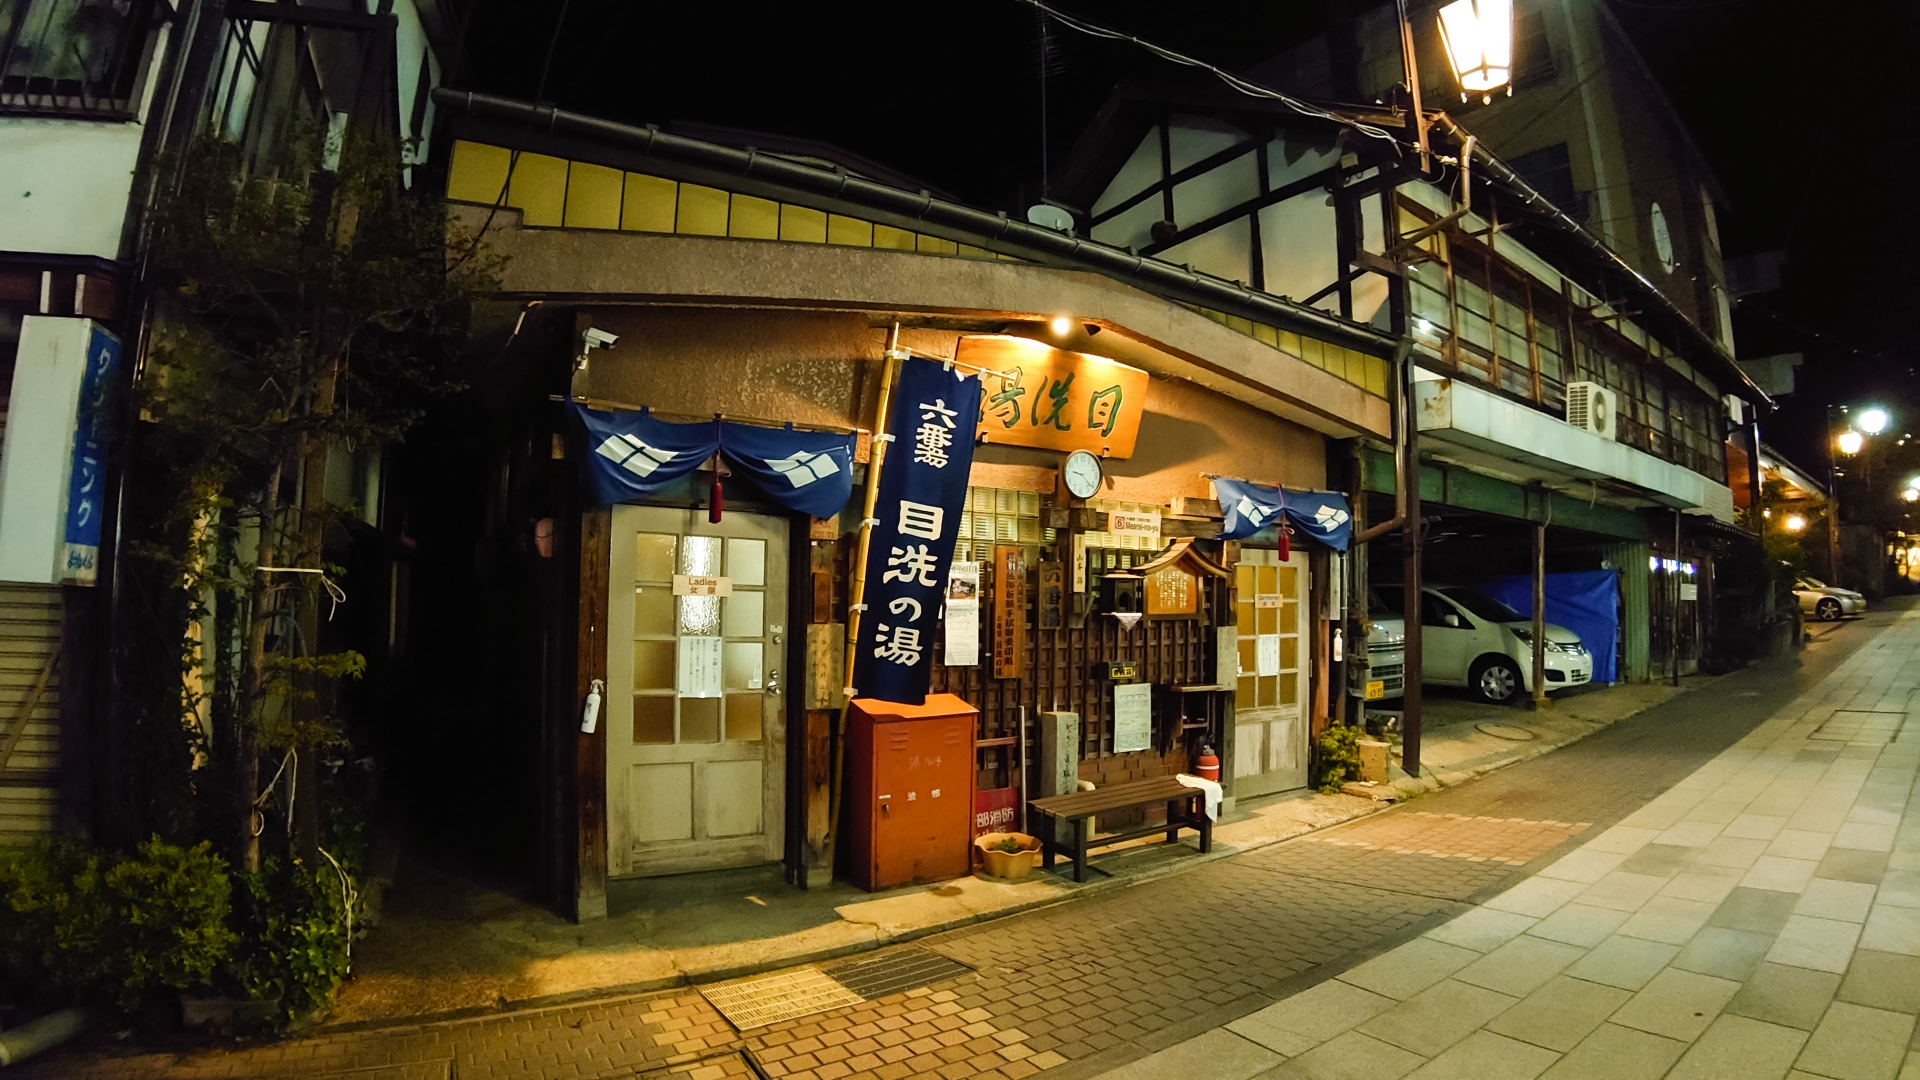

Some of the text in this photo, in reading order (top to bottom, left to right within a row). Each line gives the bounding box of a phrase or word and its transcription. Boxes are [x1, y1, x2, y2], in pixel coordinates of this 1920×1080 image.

[1117, 518, 1123, 527] 6
[874, 398, 958, 667] 六番湯 目洗の湯
[688, 577, 718, 586] Ladies
